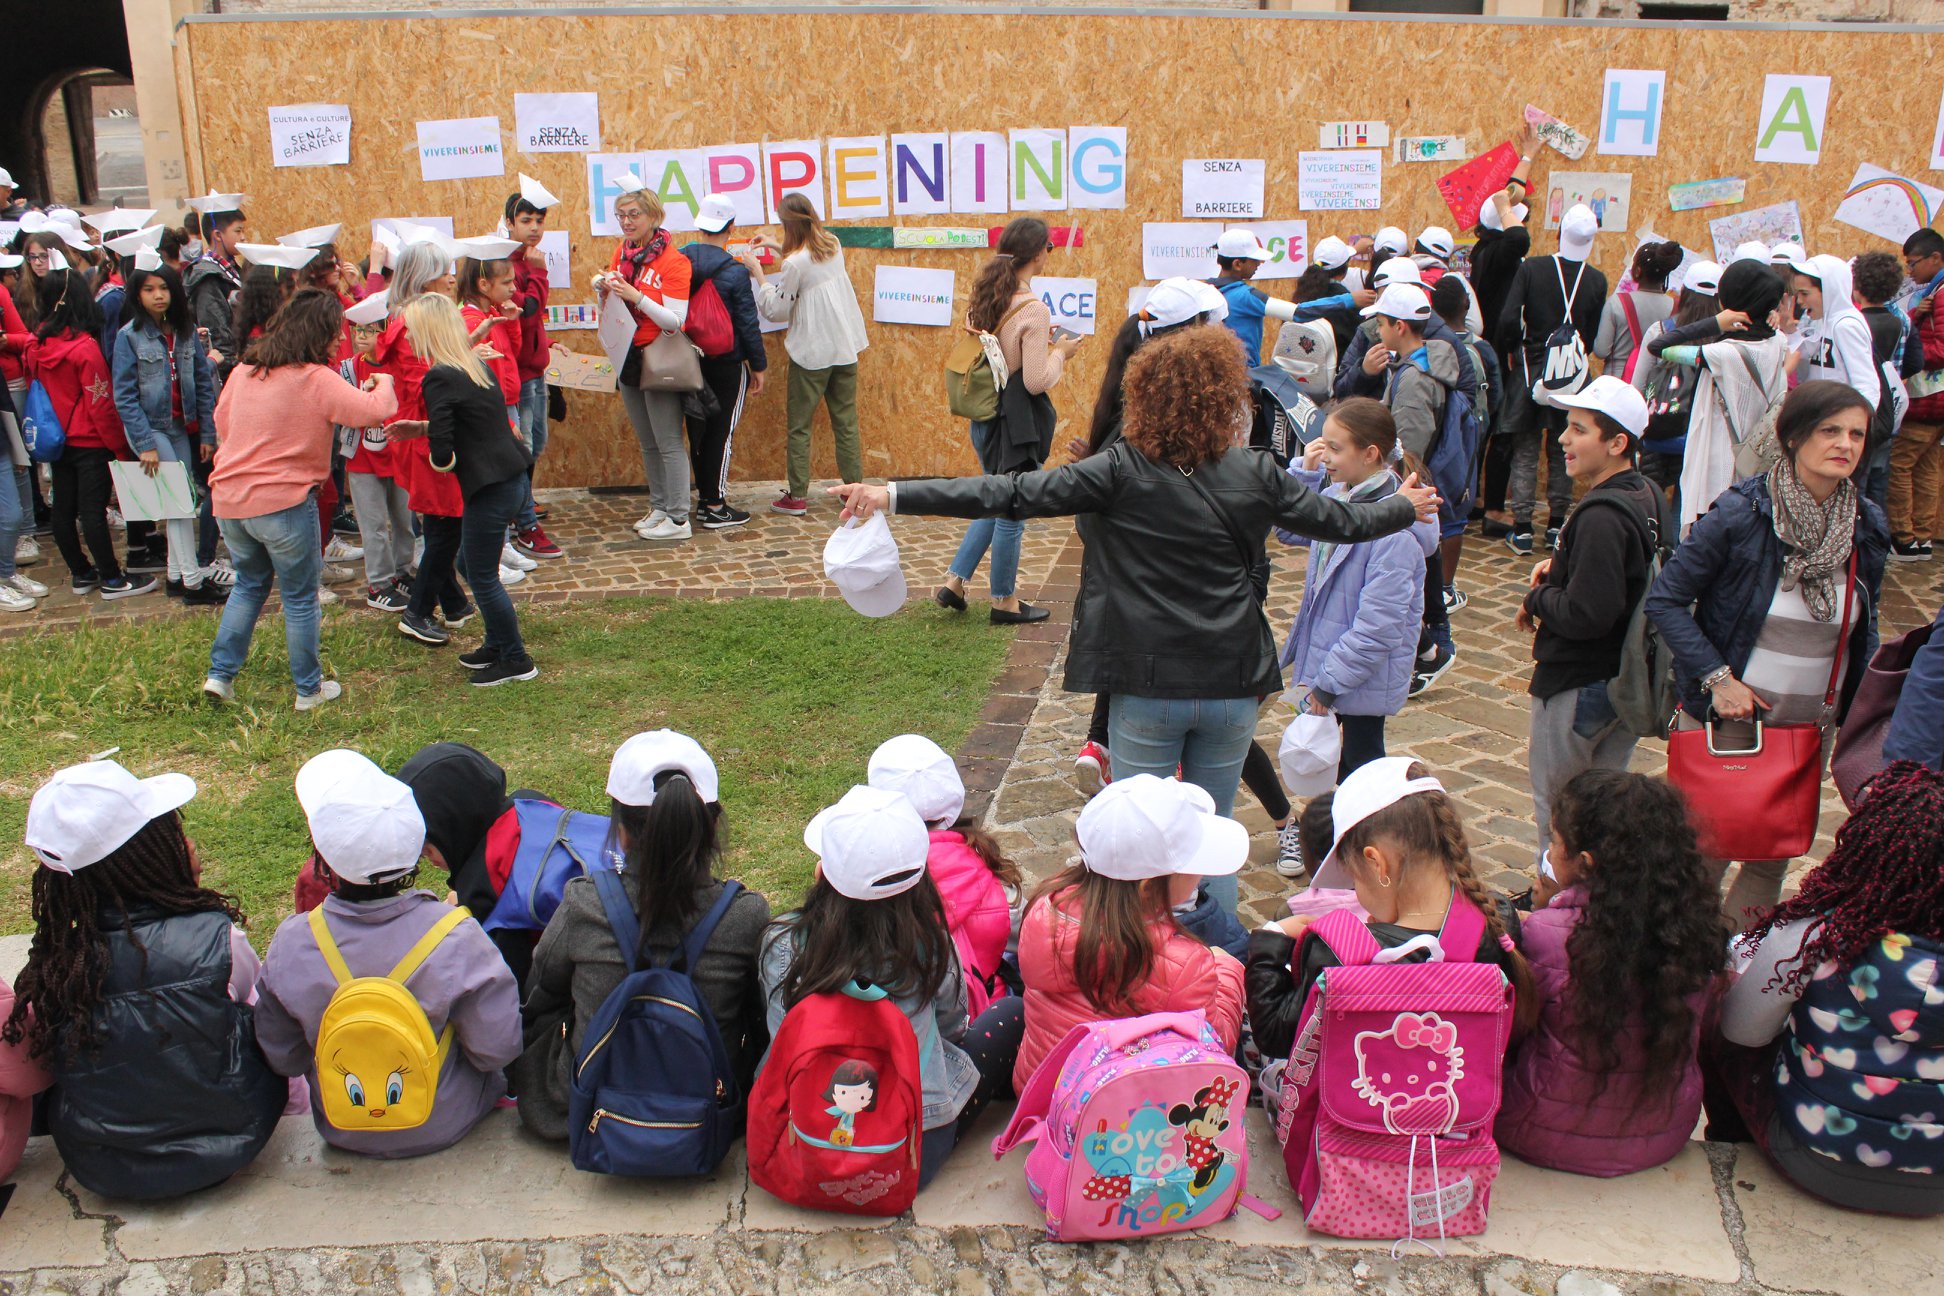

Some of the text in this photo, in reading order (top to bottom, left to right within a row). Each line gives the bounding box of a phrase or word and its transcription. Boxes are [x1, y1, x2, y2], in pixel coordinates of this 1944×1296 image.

[291, 126, 332, 145] SENZA
[540, 127, 579, 138] SENZA
[283, 132, 344, 158] BARRIERE
[530, 135, 589, 147] BARRIERE
[423, 144, 499, 158] VIVEREINSIEME
[1203, 161, 1242, 173] SENZA
[1307, 164, 1376, 173] VIVEREINSIEME
[592, 137, 1122, 224] HAPPENING
[1195, 203, 1253, 214] BARRIERE
[899, 230, 944, 244] SCUOLA
[878, 290, 950, 304] VIVEREINSIEME
[1042, 290, 1094, 318] ACE
